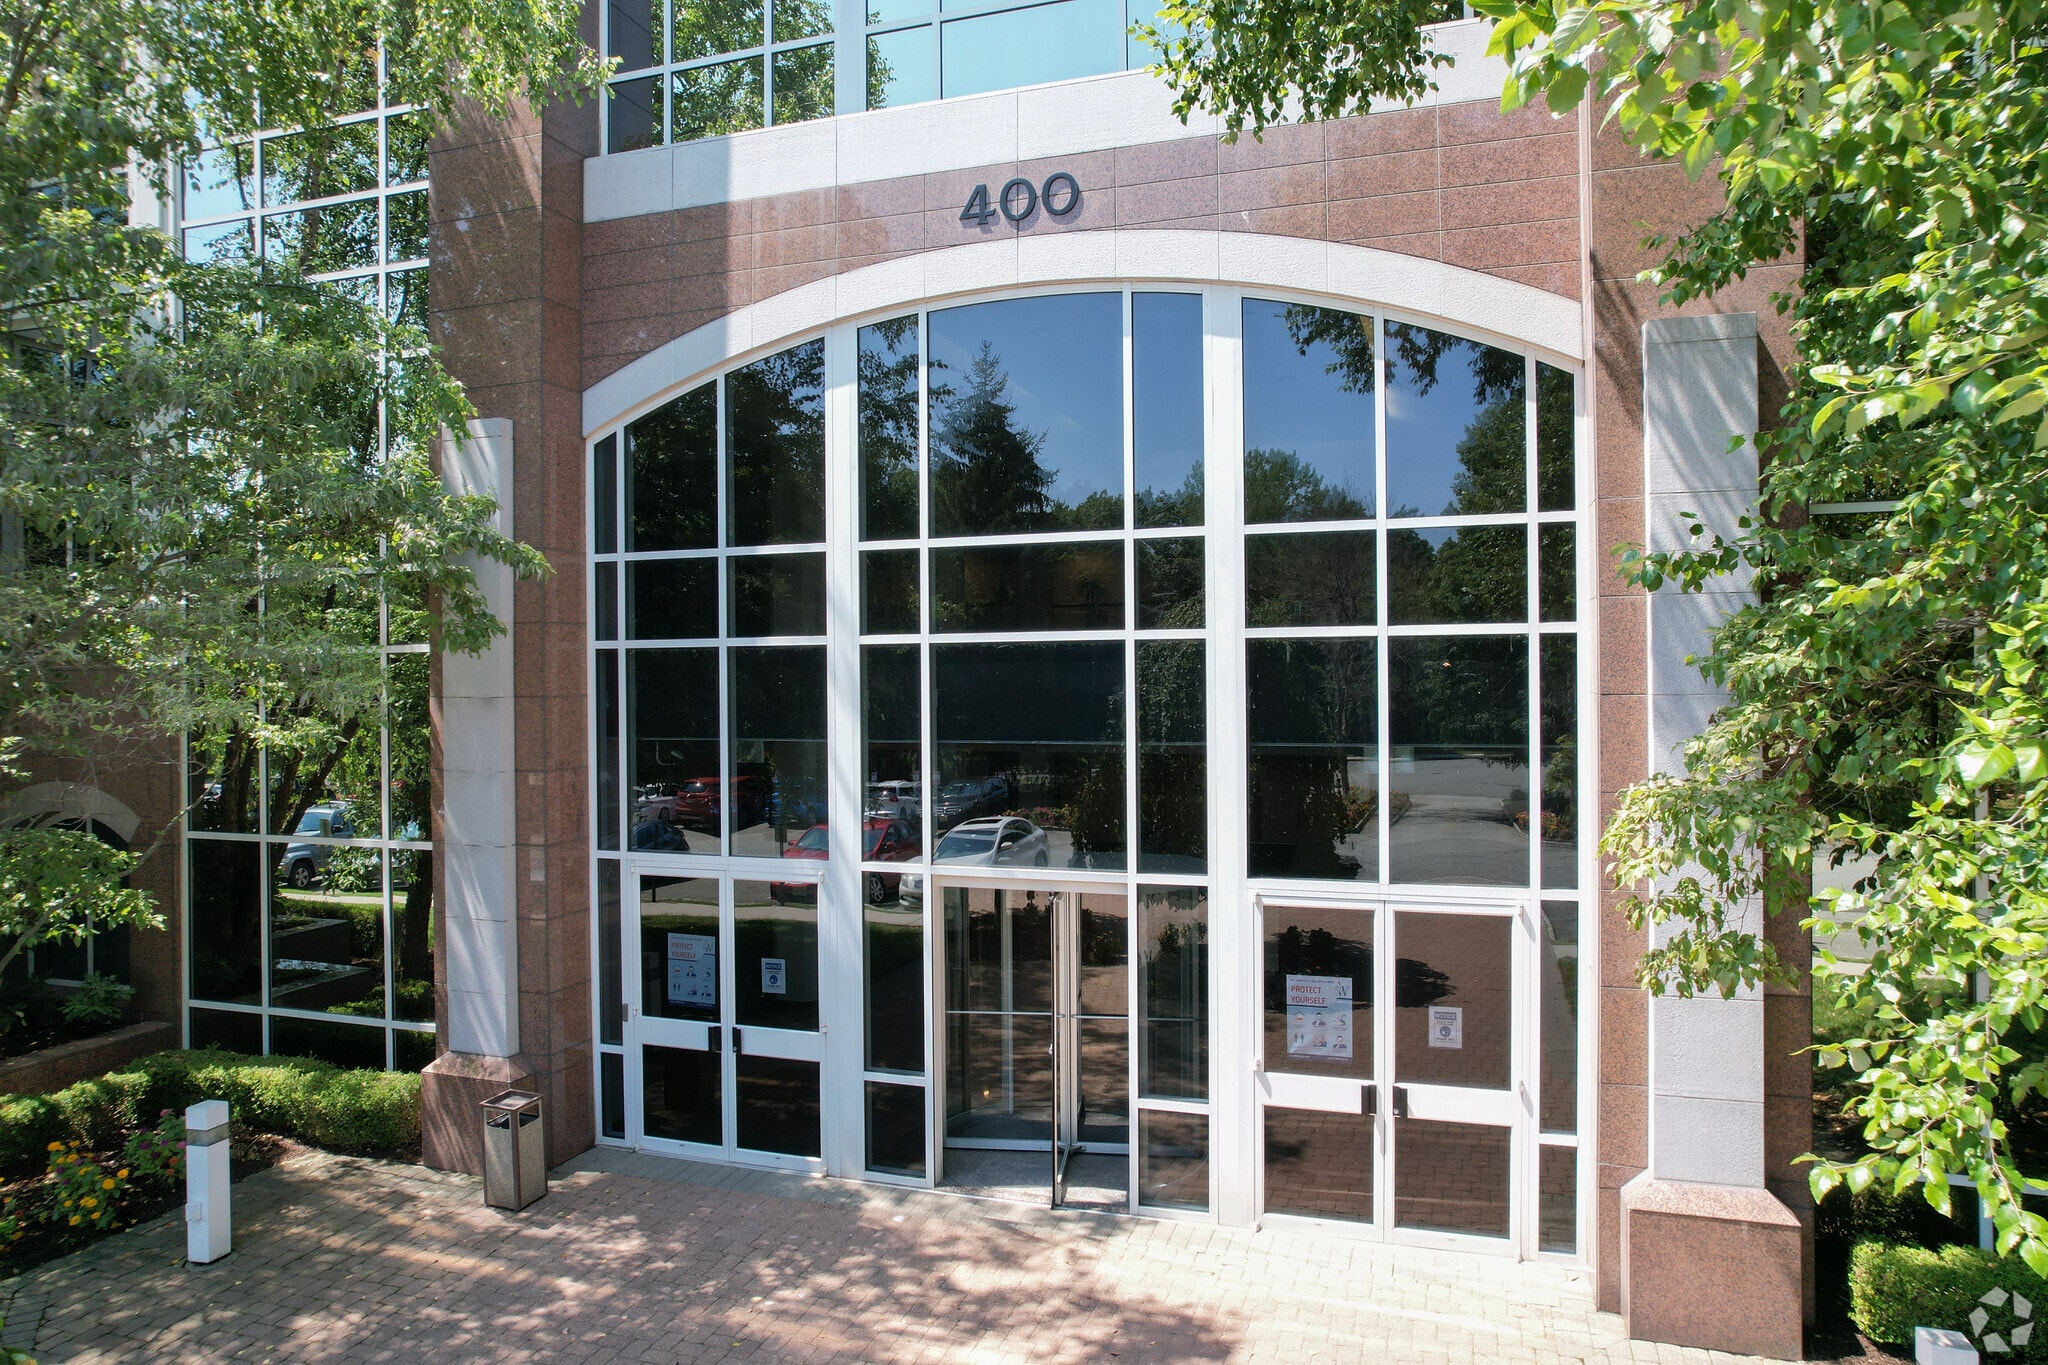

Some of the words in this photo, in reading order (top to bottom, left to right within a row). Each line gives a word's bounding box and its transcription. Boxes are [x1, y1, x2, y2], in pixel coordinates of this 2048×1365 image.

[959, 172, 1080, 225] 400
[671, 942, 693, 950] PROTECT
[671, 951, 696, 959] YOURSELF
[1291, 985, 1321, 994] PROTECT
[1291, 996, 1326, 1005] YOURSELF
[1434, 1012, 1456, 1020] NOTICE
